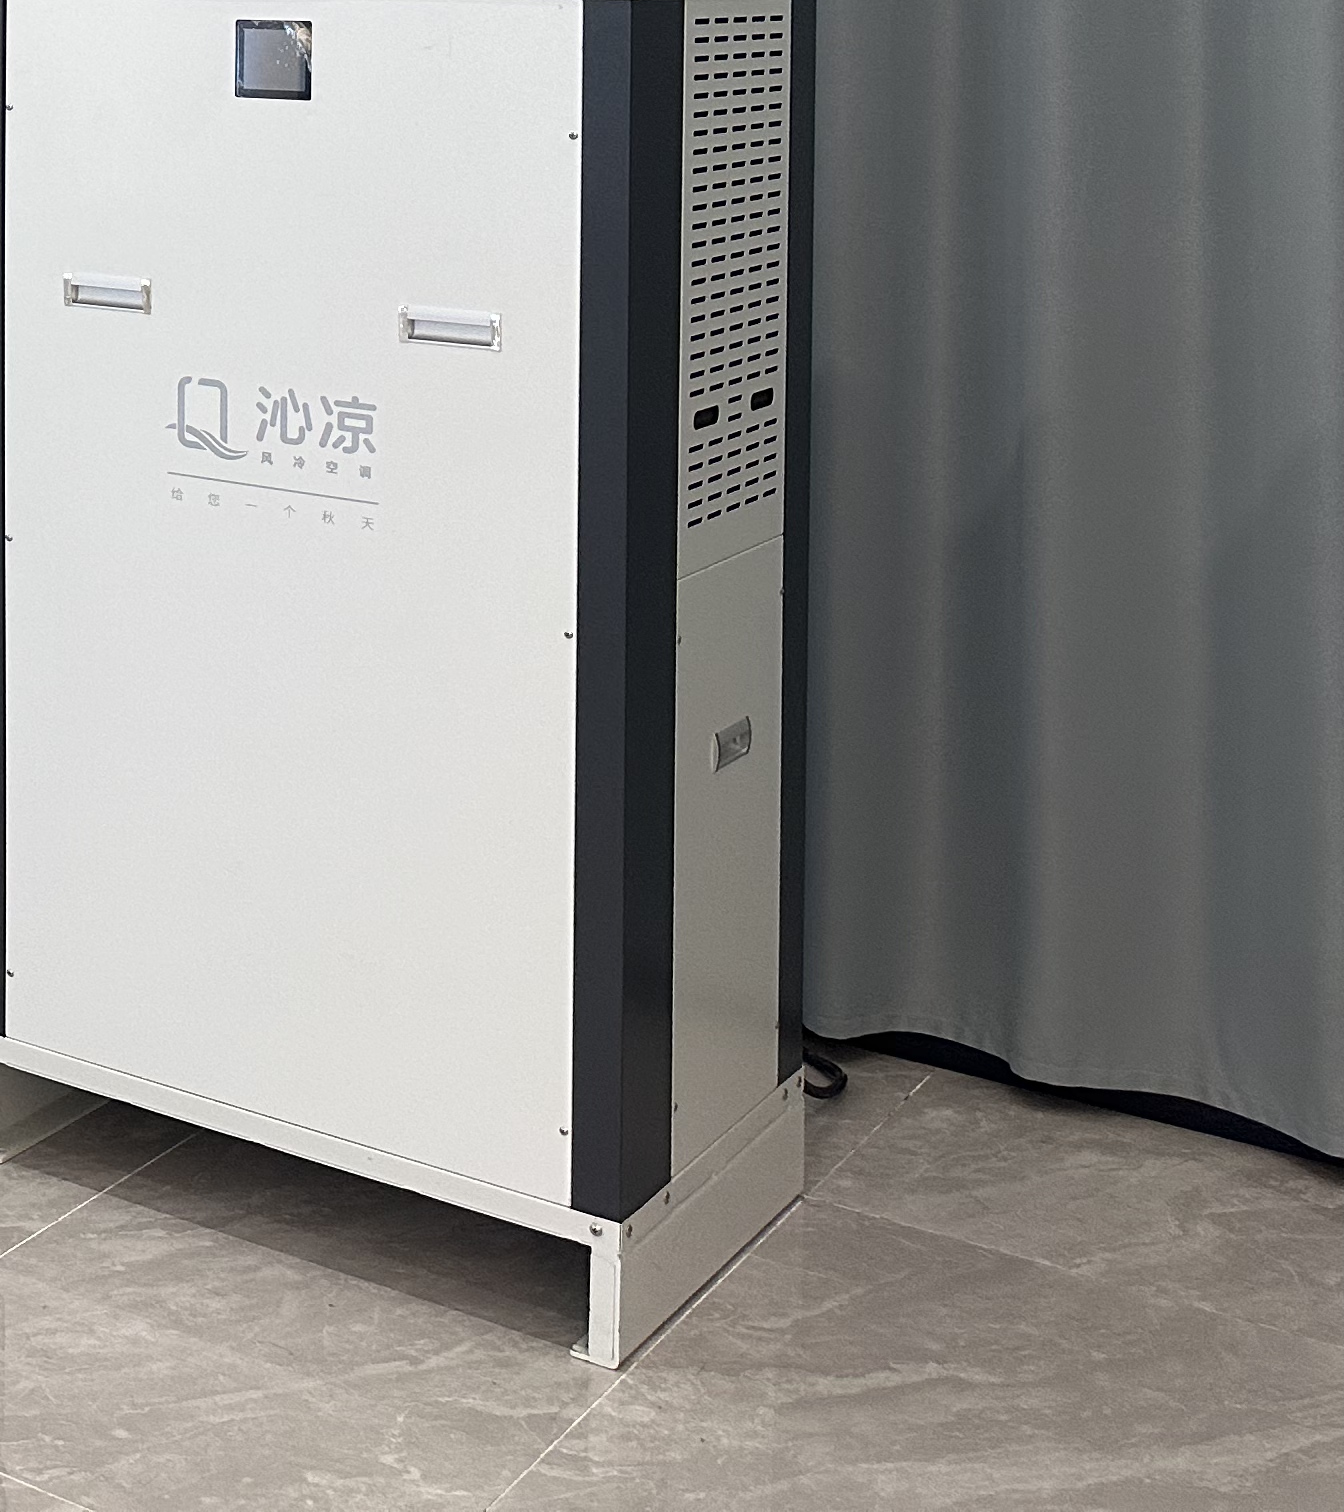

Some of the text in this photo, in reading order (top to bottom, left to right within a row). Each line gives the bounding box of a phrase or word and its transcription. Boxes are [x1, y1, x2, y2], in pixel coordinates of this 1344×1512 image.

[256, 386, 377, 454] 沁凉
[261, 451, 372, 479] 风冷空调
[170, 487, 375, 531] 给您一个秋天
